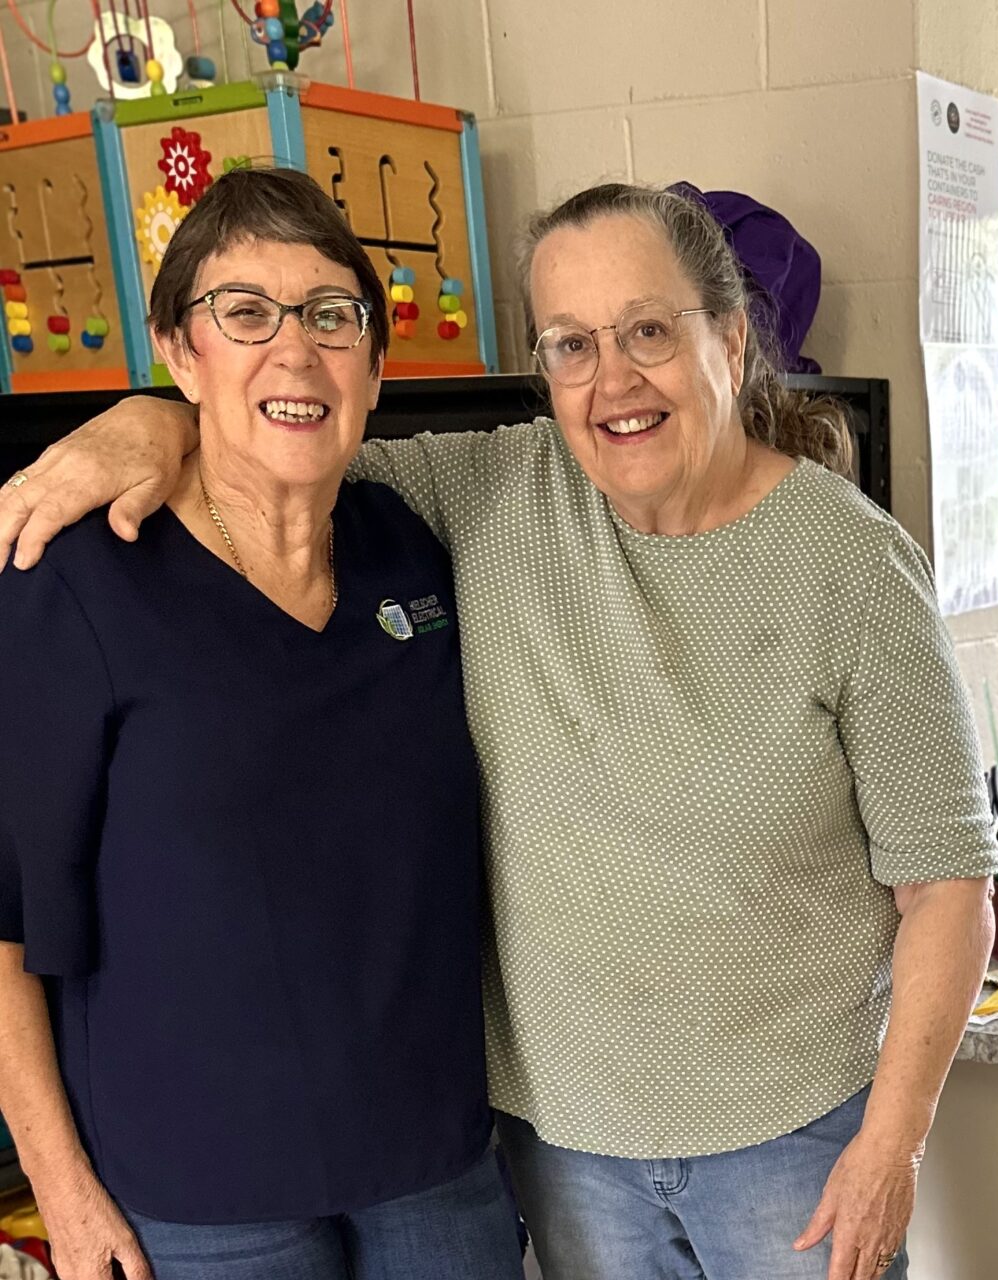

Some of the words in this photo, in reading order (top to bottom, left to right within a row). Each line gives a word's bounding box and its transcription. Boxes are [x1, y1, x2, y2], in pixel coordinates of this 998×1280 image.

[927, 150, 954, 168] DONATE
[955, 157, 967, 172] THE
[968, 161, 985, 176] CASH
[927, 178, 969, 199] CONTAINERS
[970, 188, 978, 202] TO
[950, 170, 957, 182] IN
[958, 173, 976, 187] YOUR
[927, 192, 952, 209] CAIRNS
[953, 198, 977, 214] REGION
